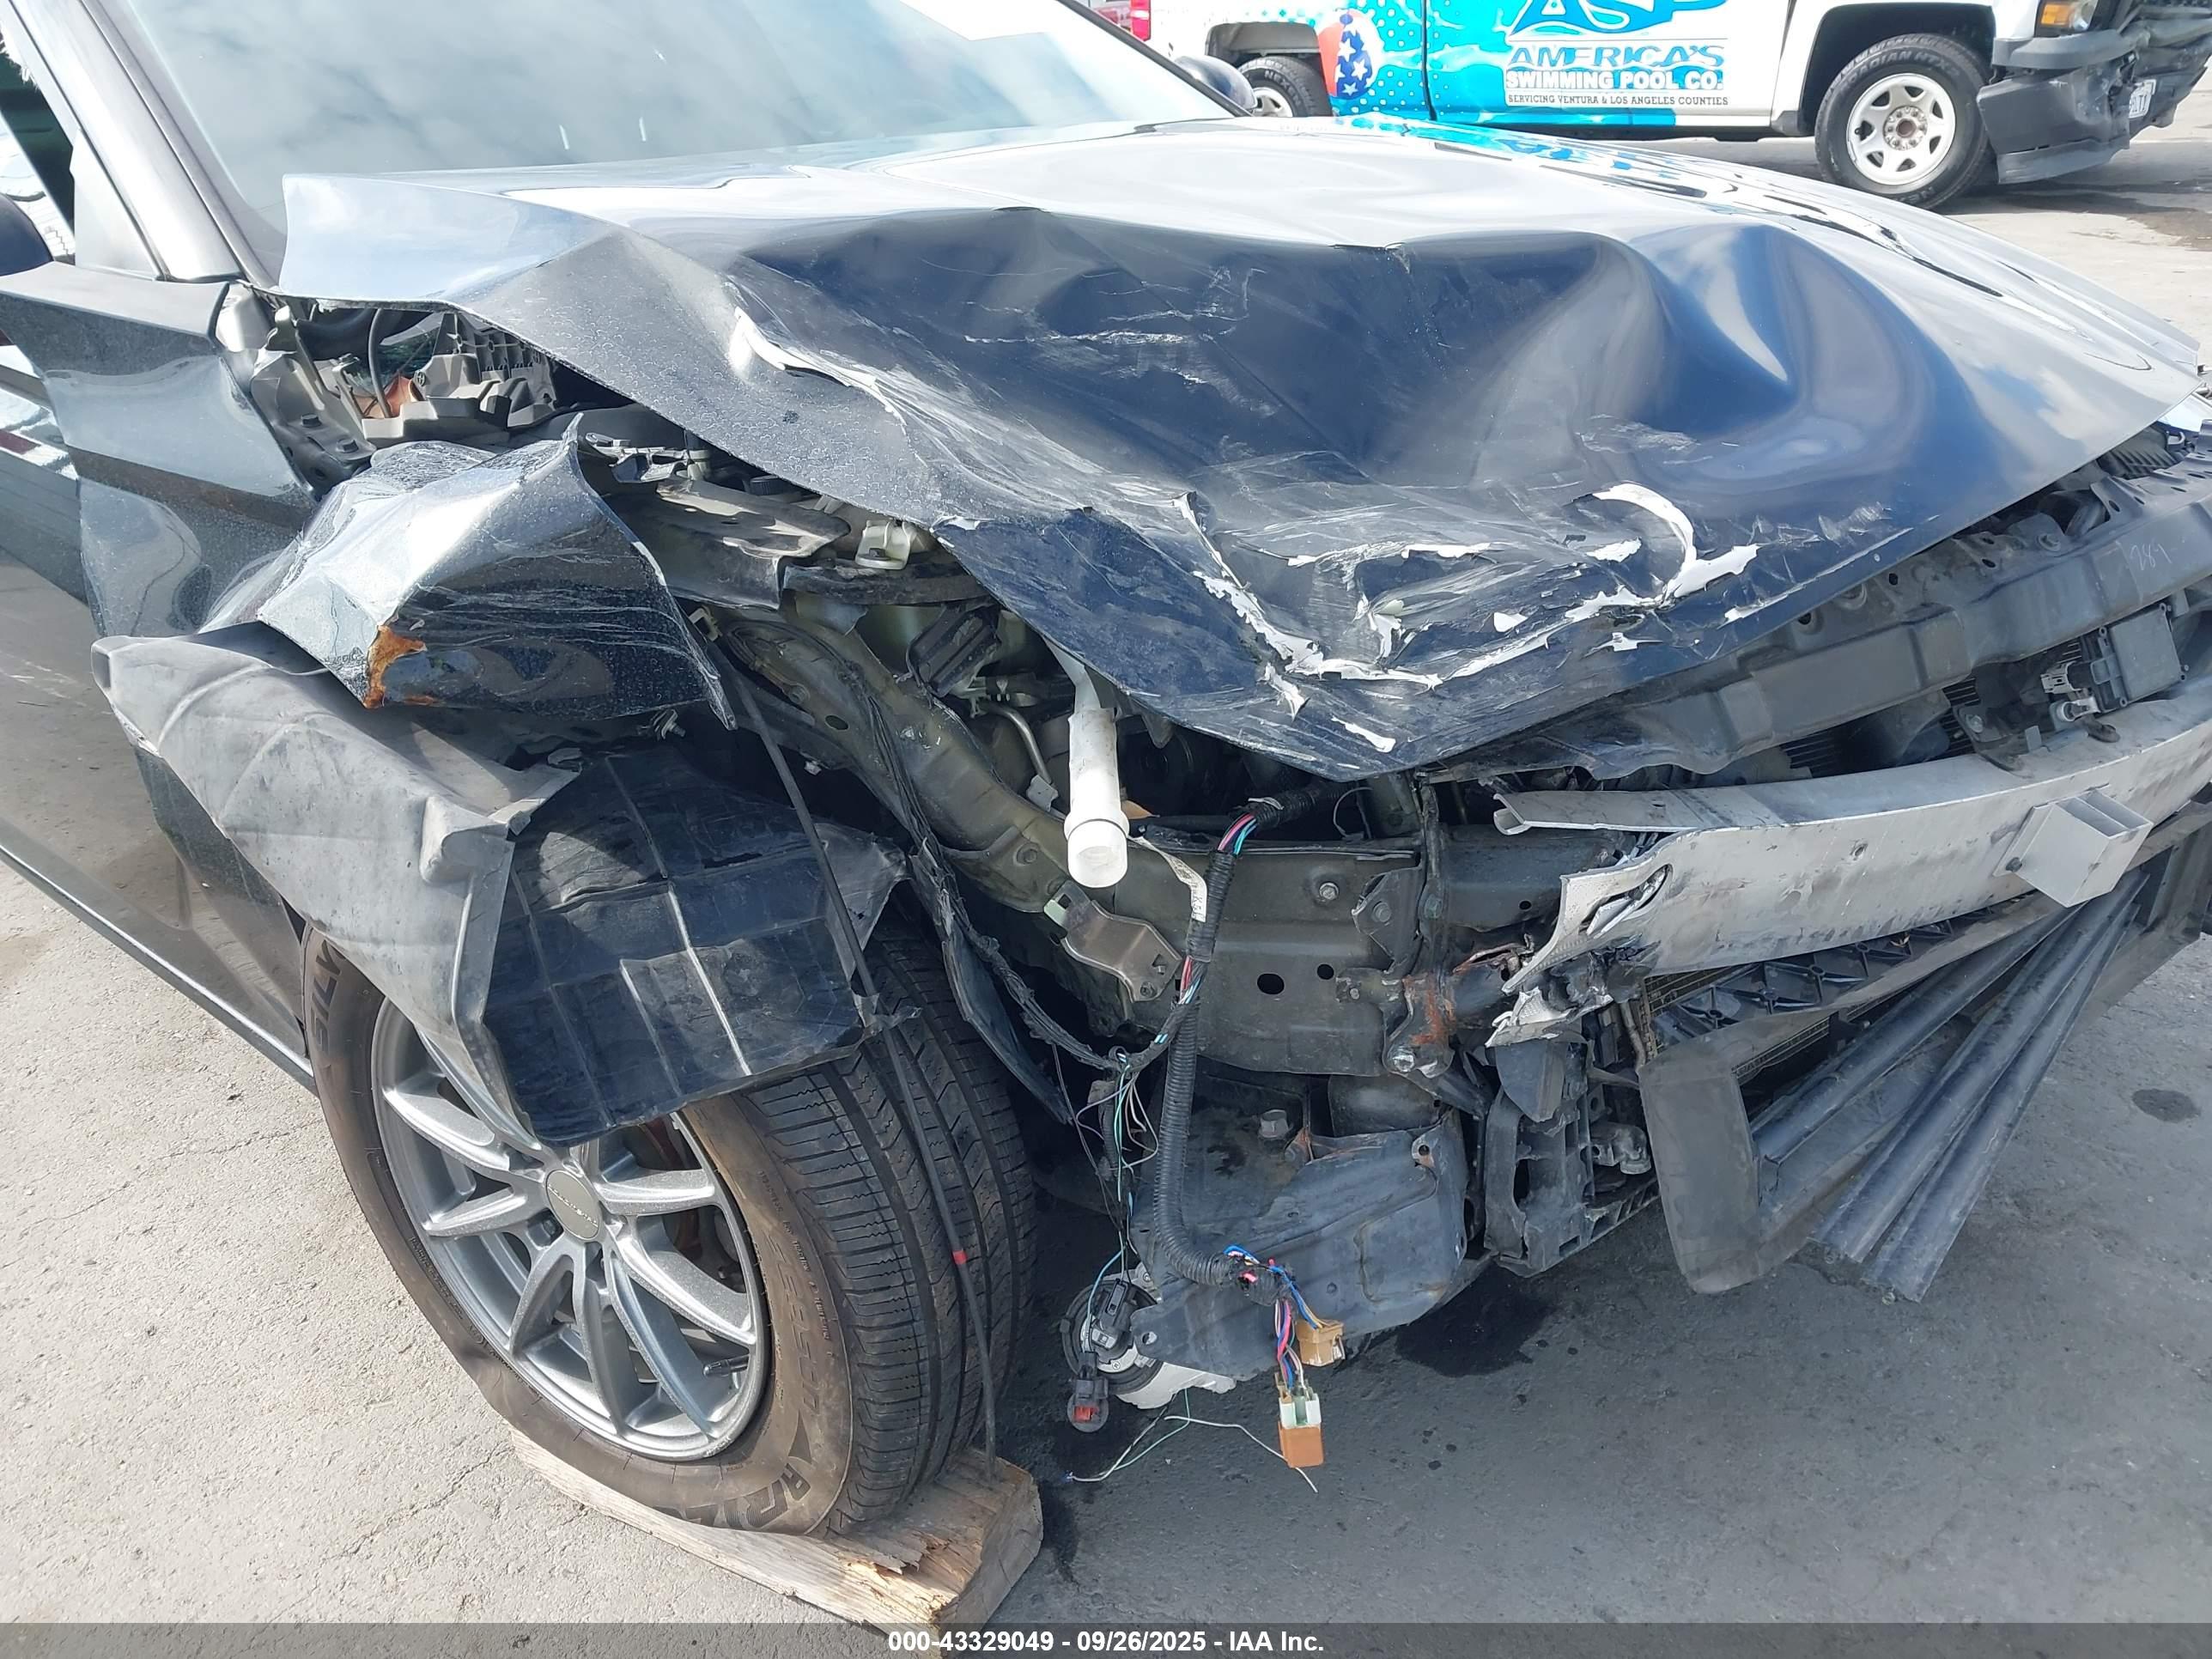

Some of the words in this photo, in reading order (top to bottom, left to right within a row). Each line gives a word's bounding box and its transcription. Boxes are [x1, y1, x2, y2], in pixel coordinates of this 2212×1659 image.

[1508, 46, 1725, 68] AMERICA'S
[1506, 70, 1614, 90] SWIMMING
[1620, 70, 1680, 90] POOL
[1684, 70, 1723, 90] CO.
[1509, 94, 1555, 104] SERVICING
[1558, 95, 1599, 104] VENTURA
[1610, 96, 1628, 105] LOS
[1631, 96, 1675, 105] ANGELES
[1678, 96, 1729, 106] COUNTIES
